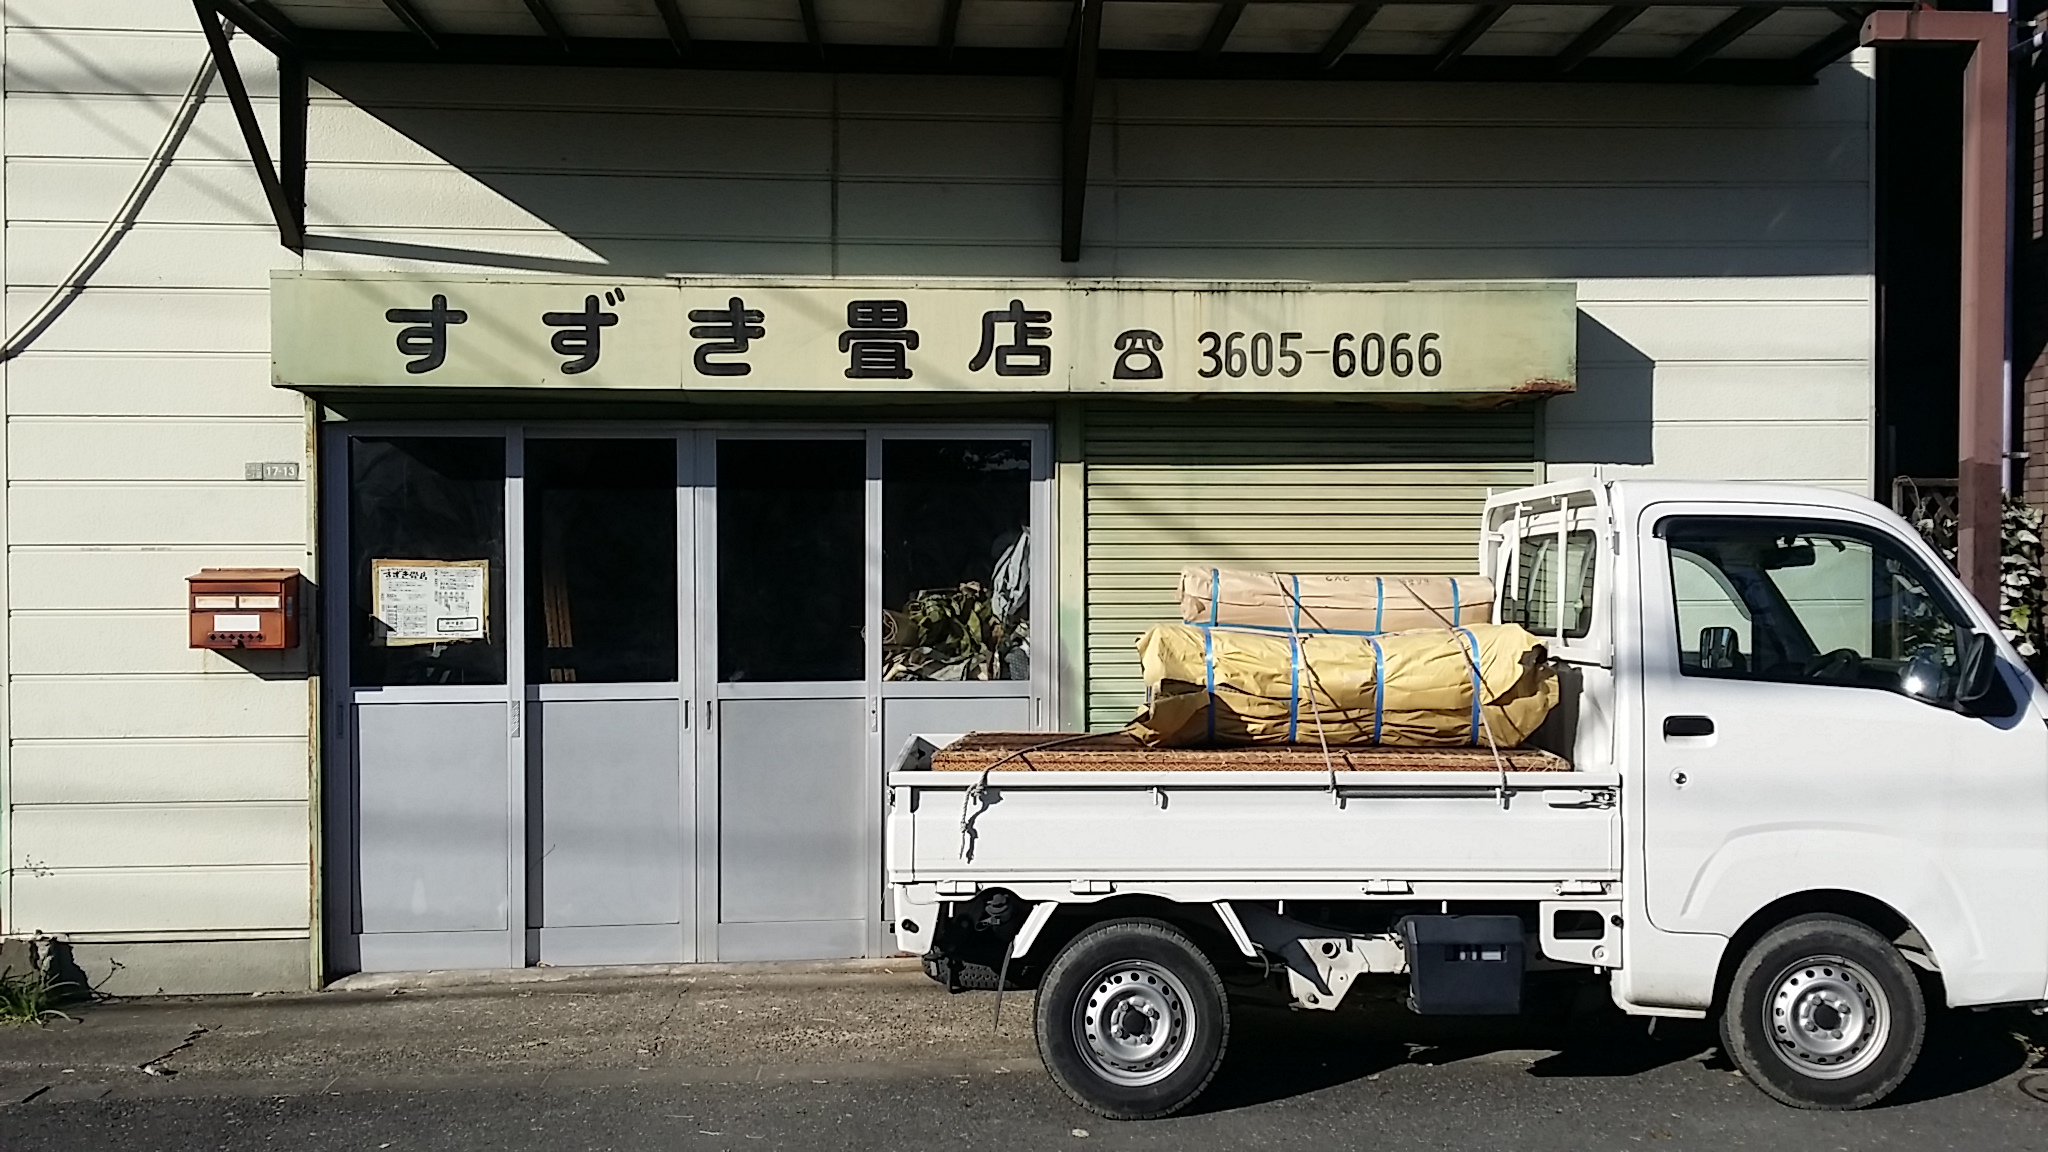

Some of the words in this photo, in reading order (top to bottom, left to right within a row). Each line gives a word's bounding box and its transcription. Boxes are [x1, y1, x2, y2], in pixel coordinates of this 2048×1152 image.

[385, 288, 1052, 379] すずき畳店
[1197, 331, 1442, 379] 3605-6066
[266, 466, 295, 476] 17-13
